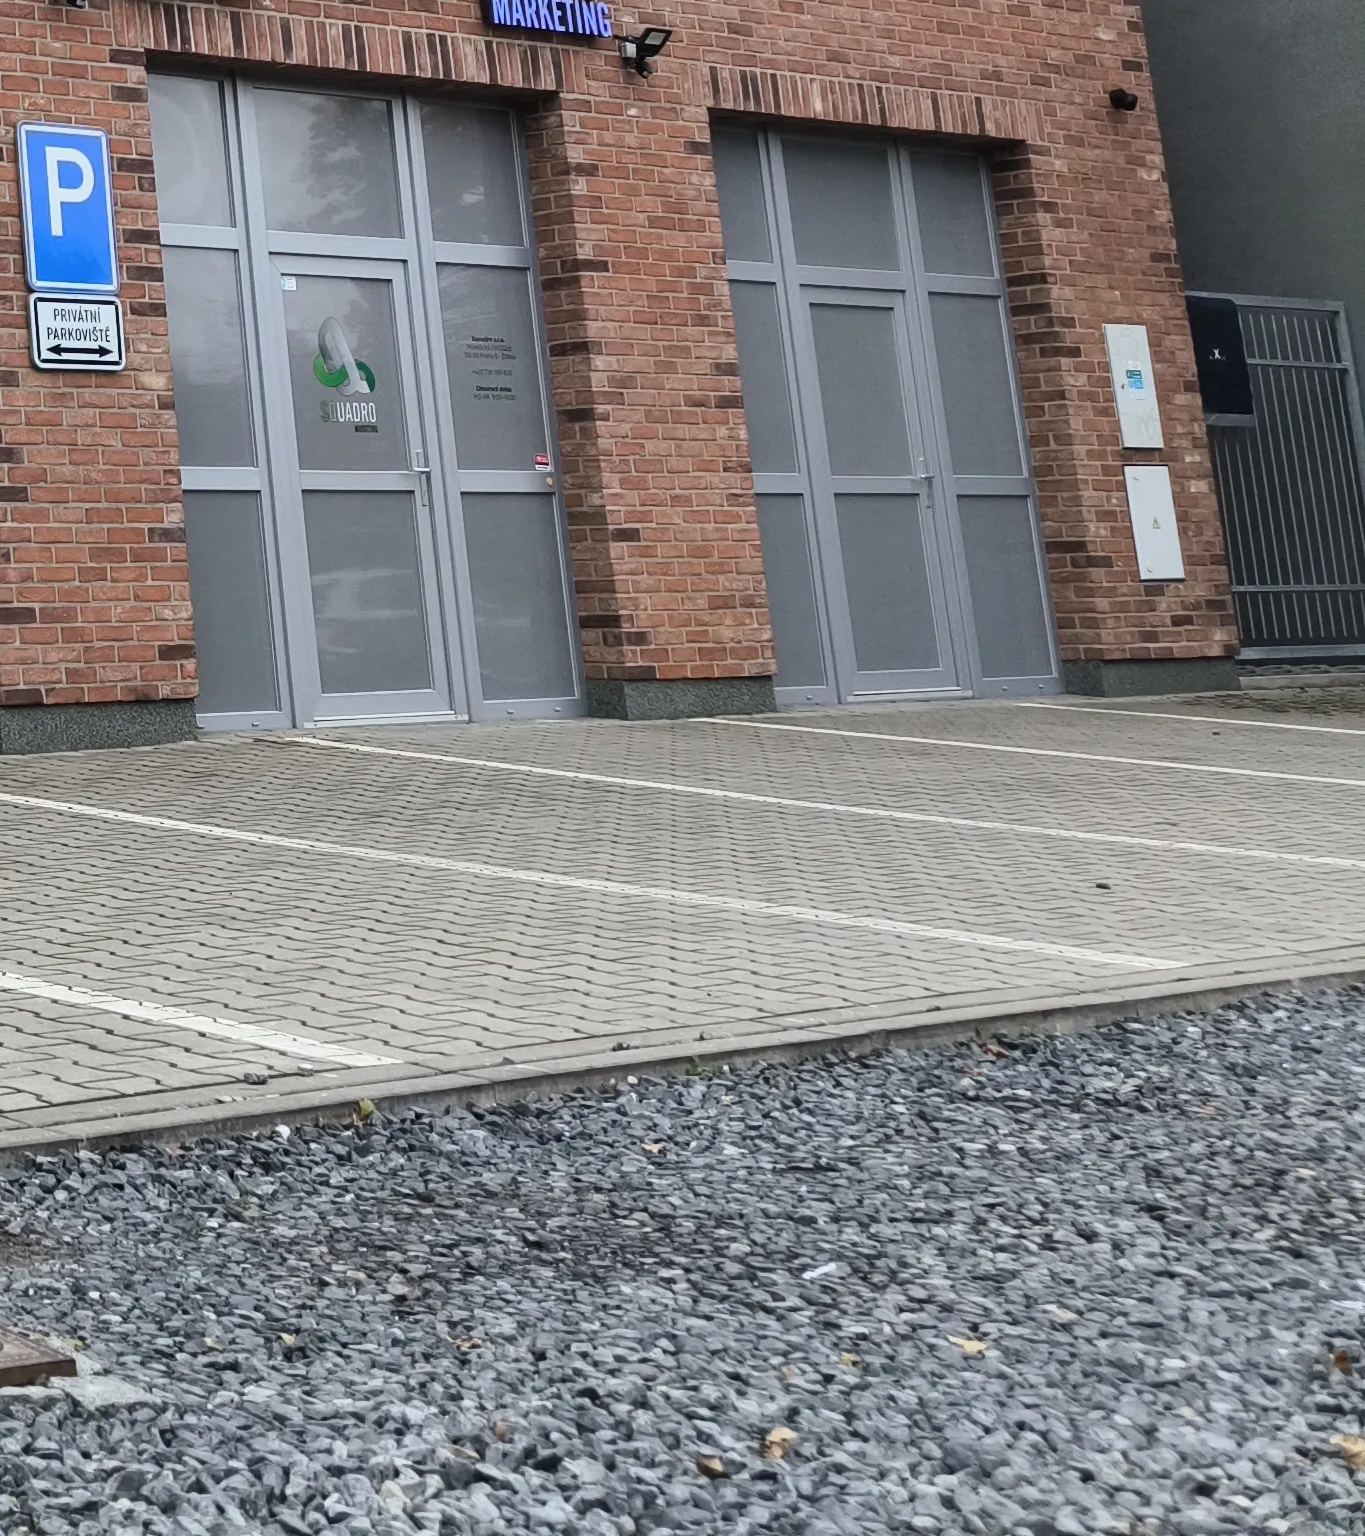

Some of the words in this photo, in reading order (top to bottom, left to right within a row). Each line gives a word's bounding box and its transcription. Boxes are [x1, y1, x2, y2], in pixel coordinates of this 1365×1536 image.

[45, 146, 95, 237] P
[53, 305, 101, 324] PRIVÁTNÍ
[47, 326, 111, 343] PARKOVIŠTĚ
[320, 400, 377, 423] SQUADRO
